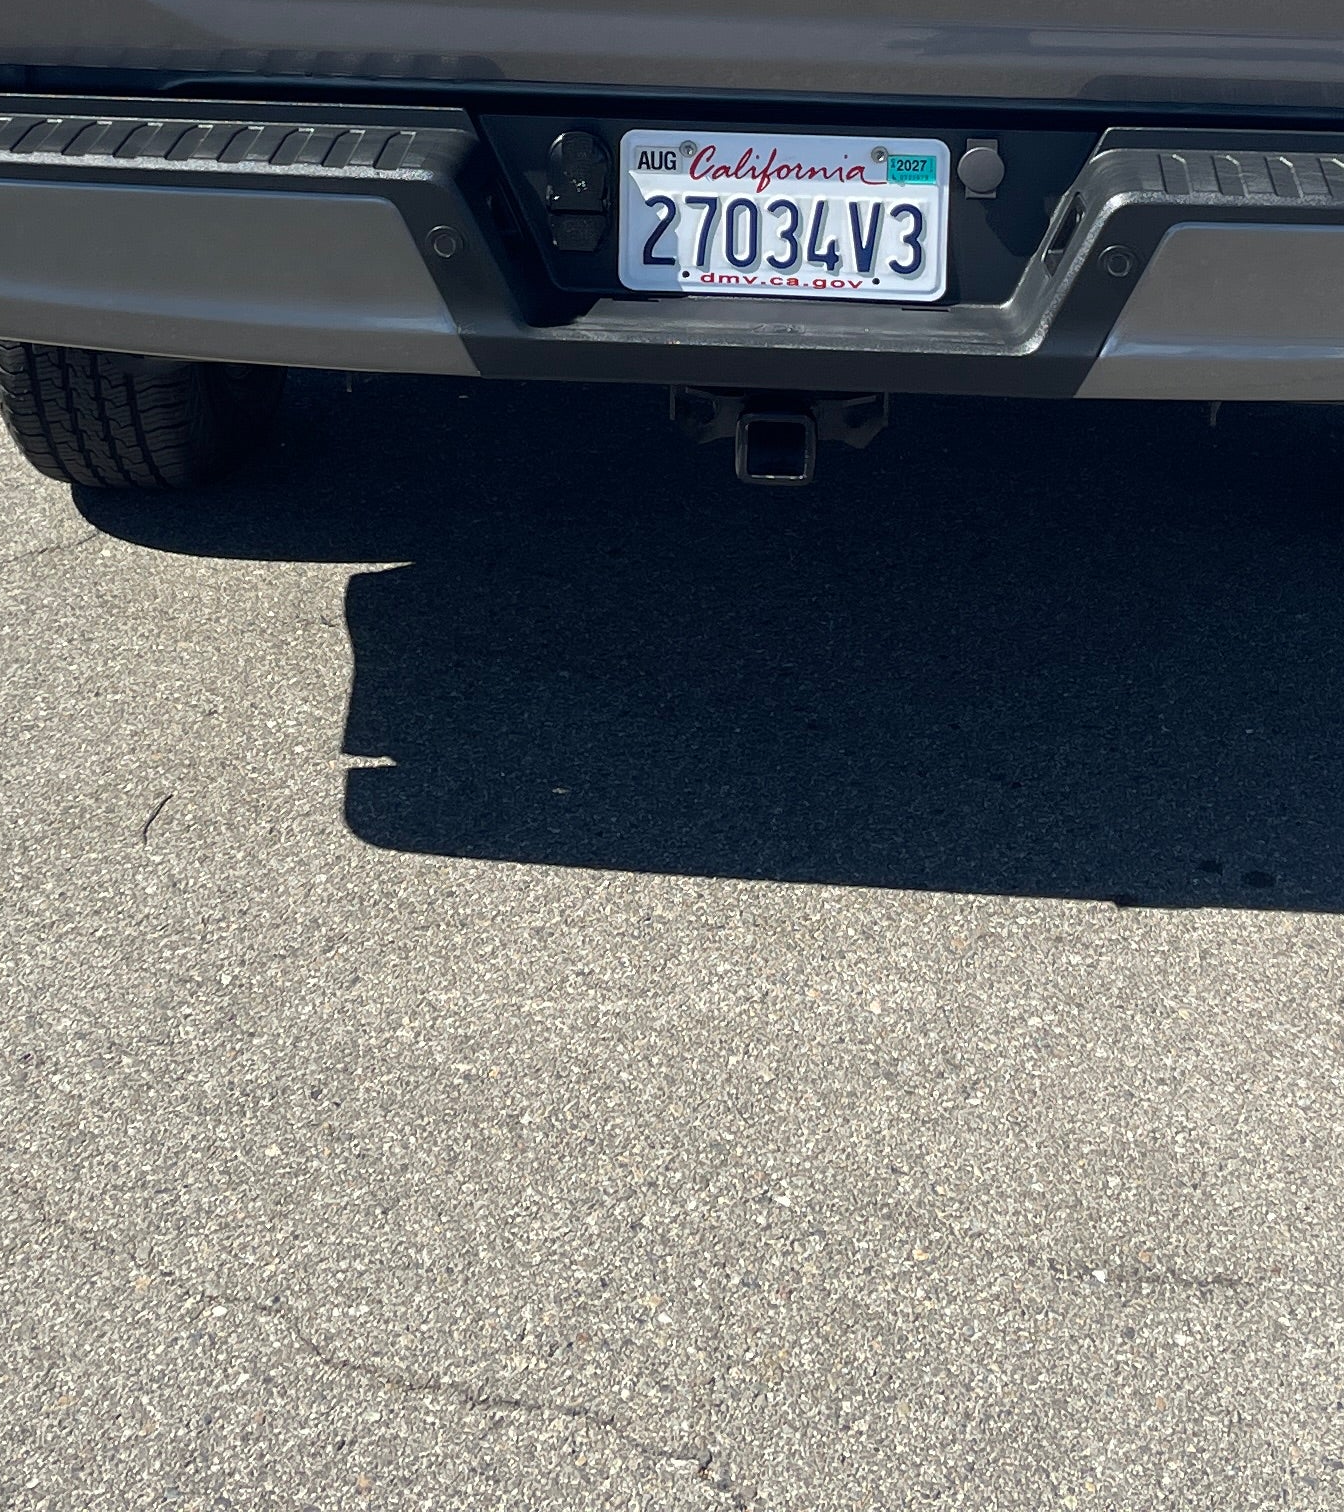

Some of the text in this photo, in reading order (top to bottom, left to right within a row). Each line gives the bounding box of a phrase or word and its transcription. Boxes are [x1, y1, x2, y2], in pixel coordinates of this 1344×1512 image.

[637, 150, 677, 170] AUG
[689, 144, 887, 193] California
[896, 159, 927, 171] 2027
[642, 194, 923, 274] 27034V3
[700, 272, 864, 289] dmv.ca.gov
